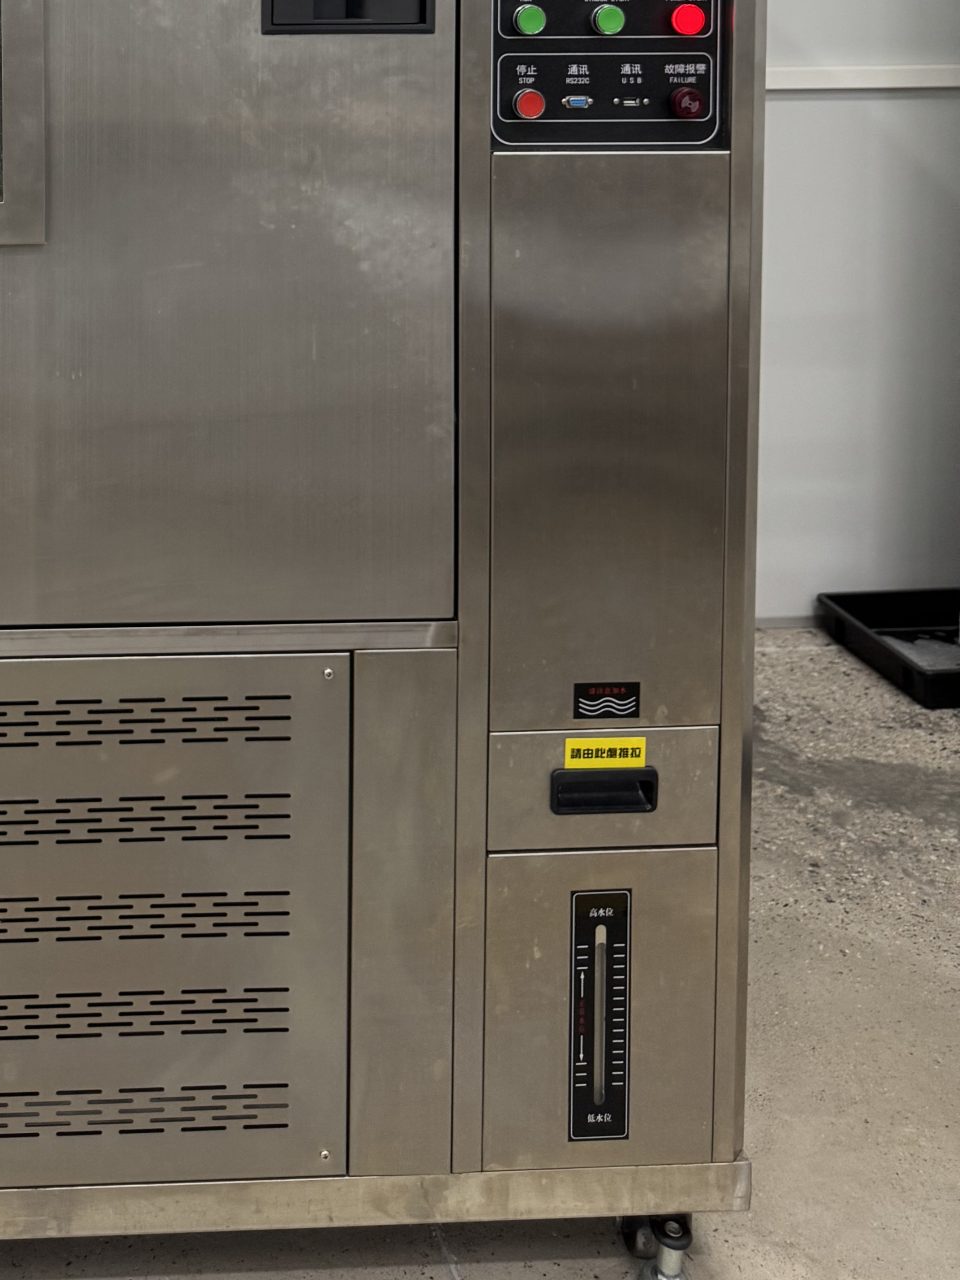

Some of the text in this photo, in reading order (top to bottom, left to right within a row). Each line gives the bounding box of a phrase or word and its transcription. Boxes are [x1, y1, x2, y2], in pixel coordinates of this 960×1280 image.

[516, 64, 538, 76] 停止
[568, 64, 589, 76] 通讯
[620, 64, 642, 75] 通讯
[664, 64, 706, 74] 故障报警
[670, 76, 696, 84] FAILURE
[589, 908, 614, 918] 高水位
[587, 1114, 612, 1123] 低水位
